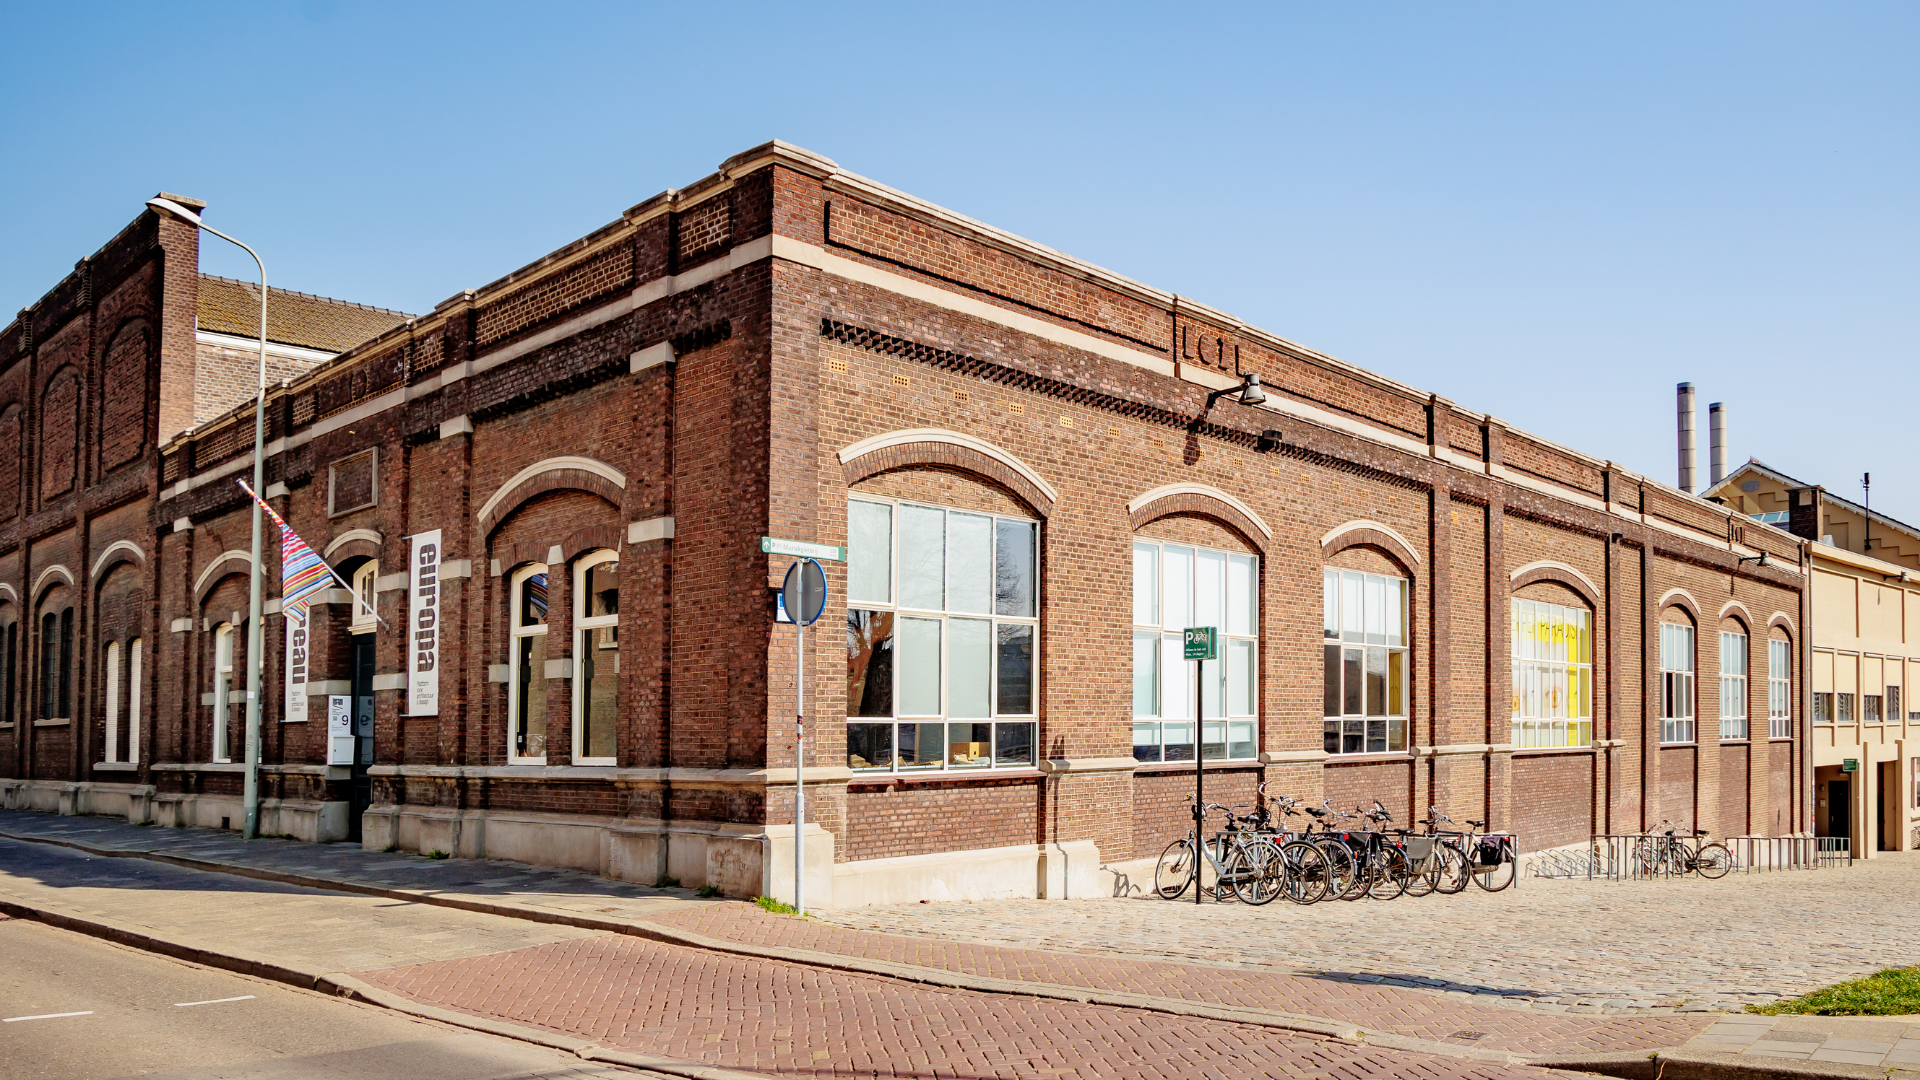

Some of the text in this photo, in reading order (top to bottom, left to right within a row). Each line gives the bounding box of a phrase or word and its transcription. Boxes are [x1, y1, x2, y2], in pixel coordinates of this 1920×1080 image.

[415, 543, 436, 673] europa
[1185, 631, 1194, 645] P
[341, 714, 349, 726] 9
